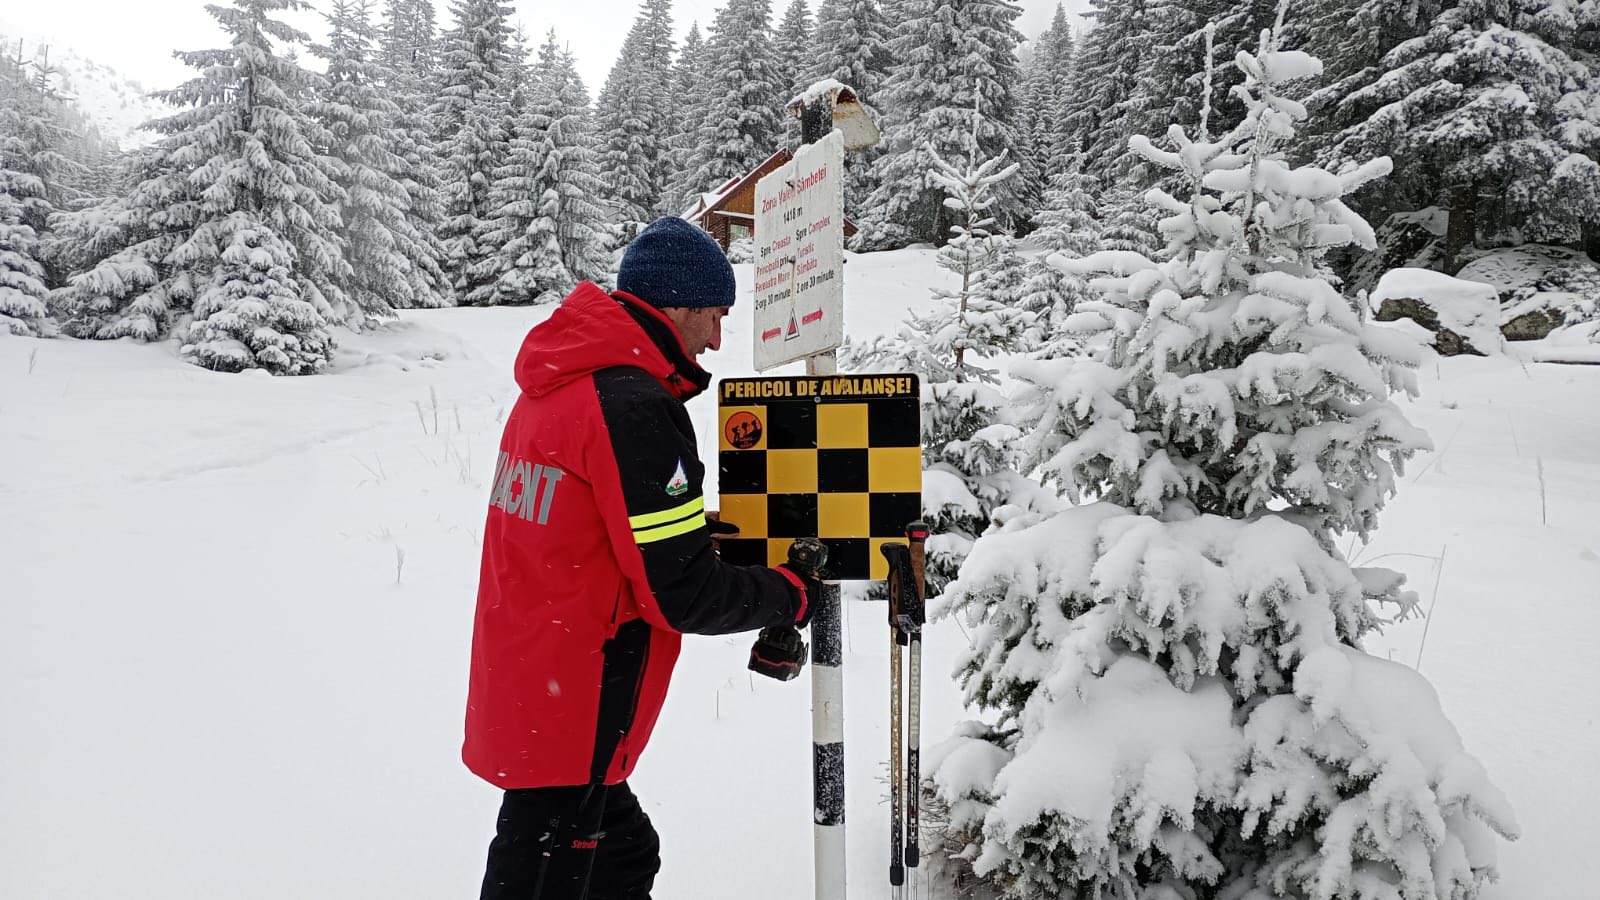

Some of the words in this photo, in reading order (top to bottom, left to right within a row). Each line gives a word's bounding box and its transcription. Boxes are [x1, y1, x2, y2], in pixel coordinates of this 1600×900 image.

[762, 198, 778, 214] Zona
[797, 206, 803, 218] m
[795, 227, 807, 242] Spre
[808, 215, 831, 235] Complex
[760, 245, 771, 259] Spre
[796, 282, 800, 294] 2
[800, 281, 809, 293] ore
[809, 275, 816, 289] 30
[816, 269, 835, 284] minute
[767, 293, 774, 305] 30
[774, 288, 791, 303] minute
[724, 380, 792, 398] PERICOL
[796, 379, 818, 396] DE
